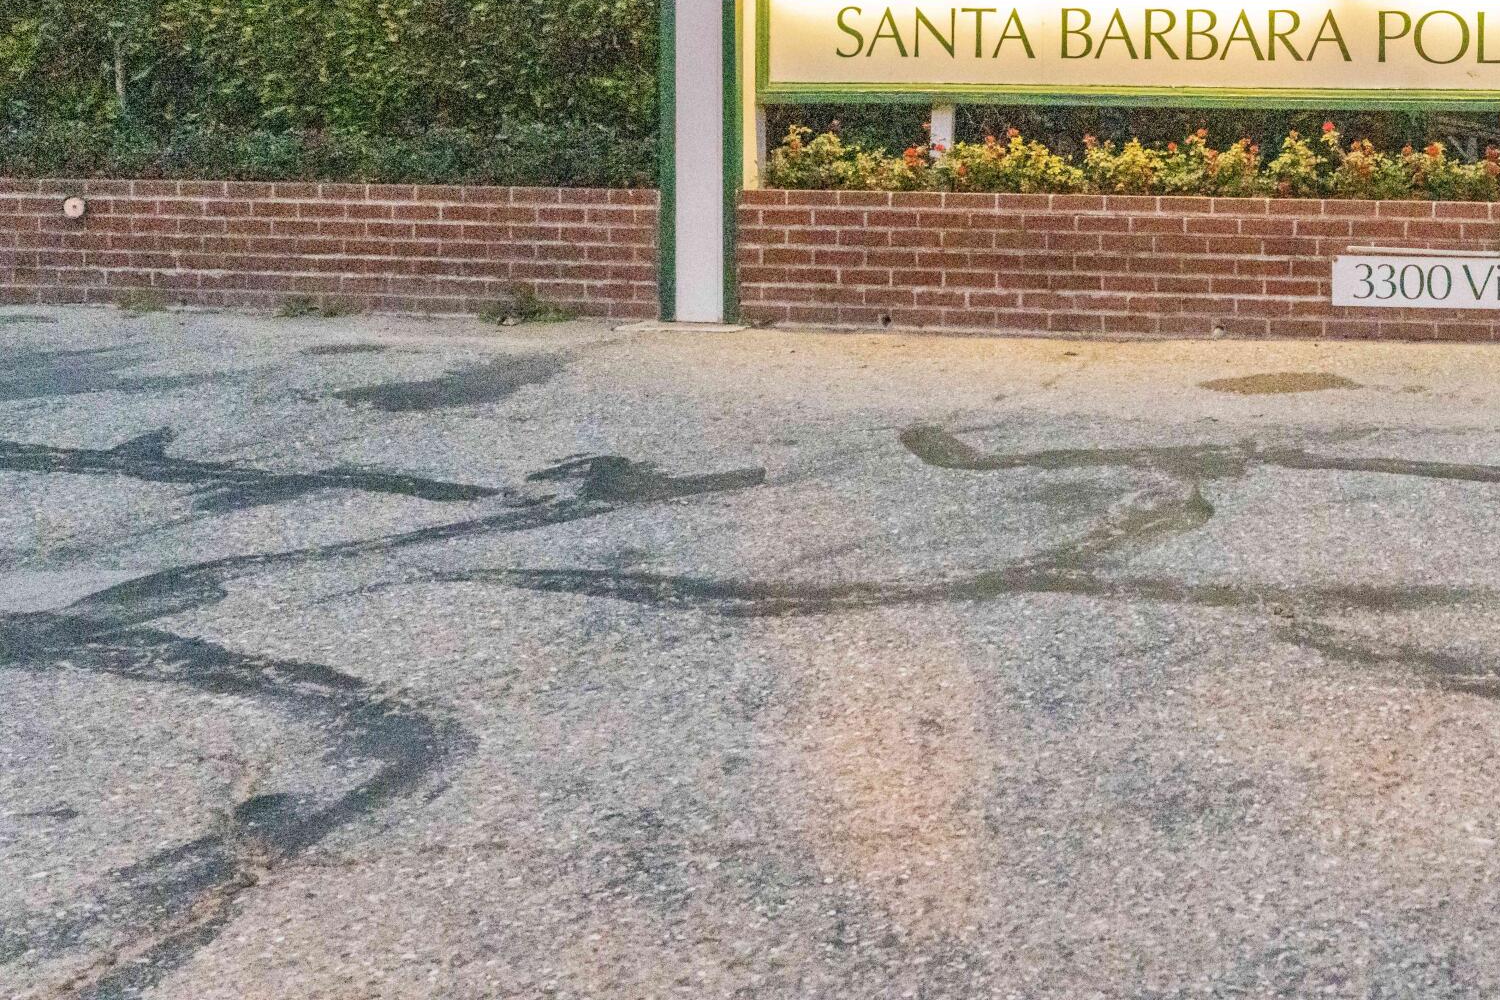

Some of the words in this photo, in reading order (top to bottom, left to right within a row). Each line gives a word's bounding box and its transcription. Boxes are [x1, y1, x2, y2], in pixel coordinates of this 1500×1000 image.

[835, 6, 1036, 59] SANTA
[1060, 7, 1352, 63] BARBARA
[1353, 263, 1452, 300] 3300
